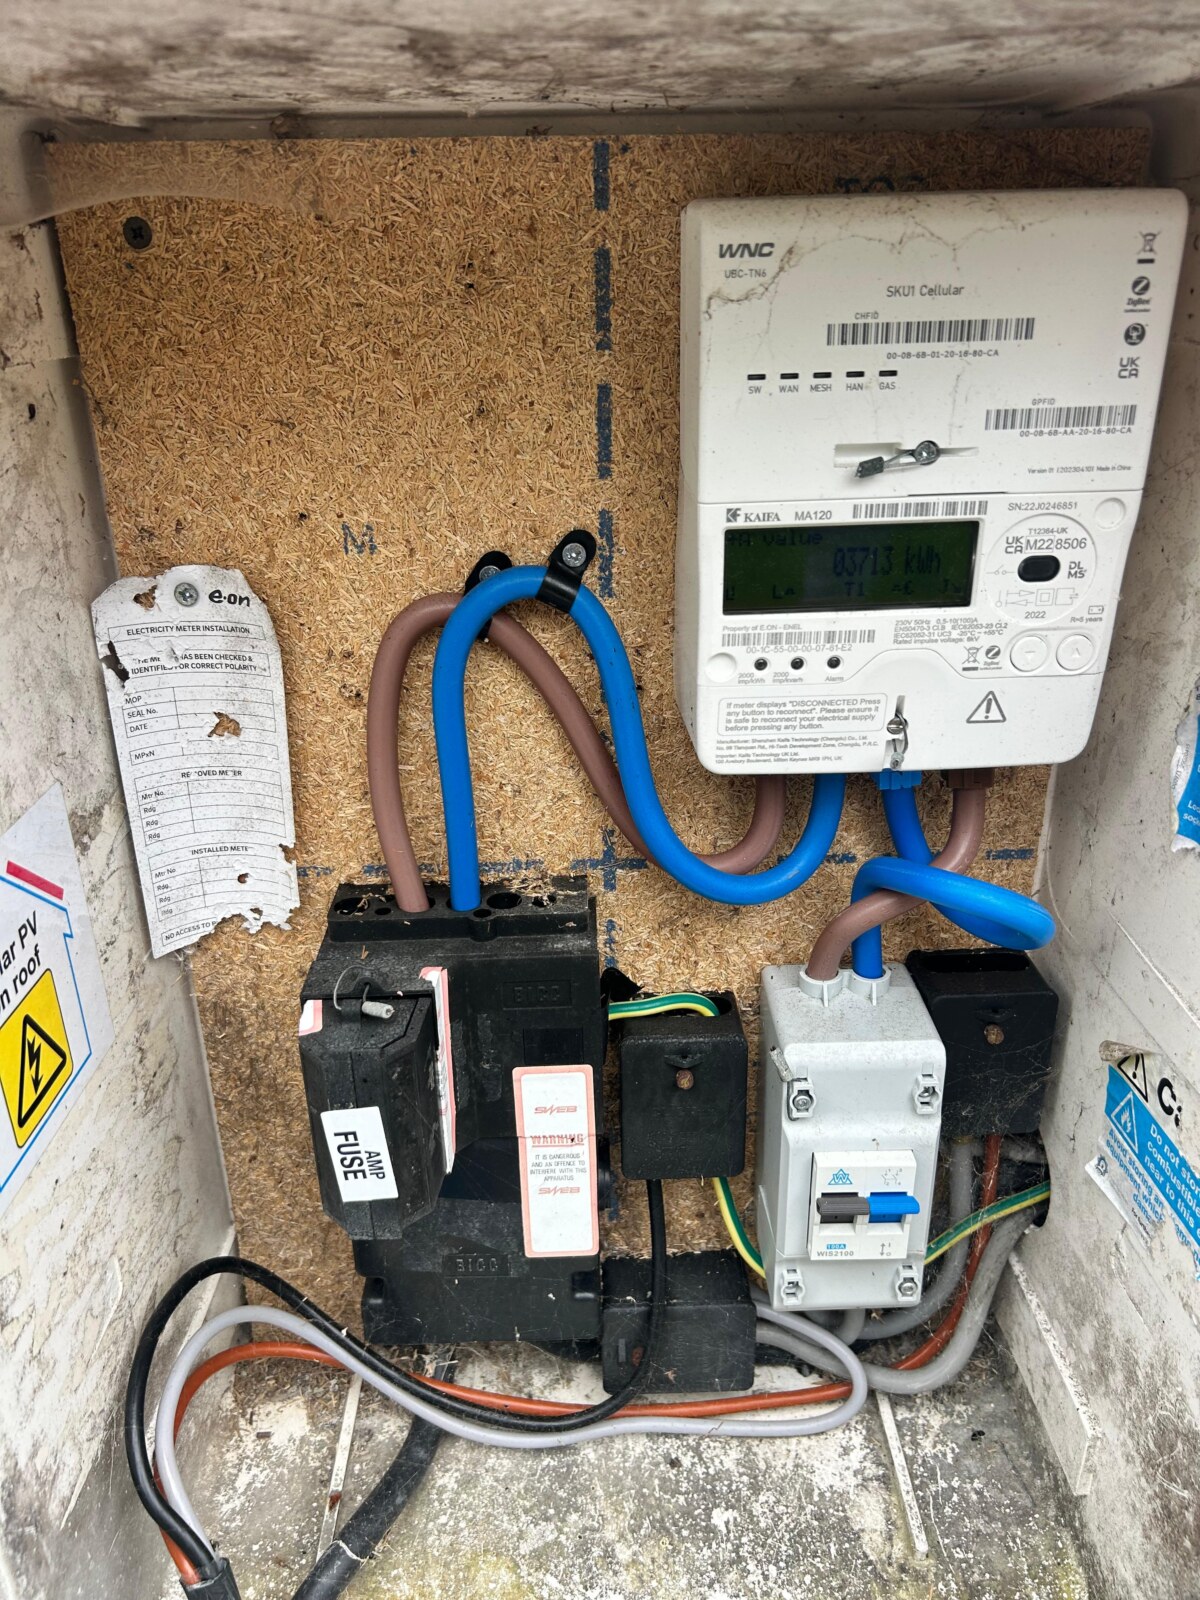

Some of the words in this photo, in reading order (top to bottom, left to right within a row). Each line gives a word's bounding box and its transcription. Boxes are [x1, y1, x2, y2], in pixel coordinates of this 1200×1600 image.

[719, 242, 775, 258] WNC
[724, 268, 767, 279] UBC-TN6
[886, 285, 915, 297] SKU1
[919, 284, 965, 297] Cellular
[854, 311, 879, 320] CHFID
[1119, 356, 1140, 367] UK
[1118, 368, 1139, 379] CA
[748, 386, 762, 394] SW
[779, 385, 799, 393] WAN
[810, 384, 832, 392] MESH
[846, 383, 864, 391] HAN
[878, 382, 896, 390] GAS
[1031, 398, 1056, 406] GPFID
[1007, 502, 1078, 512] SN:22J0246851
[744, 512, 781, 522] KAIFA
[794, 510, 833, 521] MA120
[1006, 536, 1024, 545] UK
[1004, 545, 1023, 554] CA
[1024, 611, 1047, 619] 2022
[126, 626, 175, 636] ELECTRICITY
[202, 625, 250, 634] INSTALLATION
[214, 653, 247, 662] CHECKED
[131, 664, 173, 675] IDENTIFIE
[190, 662, 224, 670] CORRECT
[224, 663, 257, 672] POLARITY
[125, 695, 142, 705] MOP
[756, 700, 787, 709] displays
[127, 710, 145, 719] SEAL
[726, 710, 740, 718] any
[742, 708, 765, 716] button
[820, 706, 846, 714] Please
[798, 715, 815, 723] your
[129, 724, 148, 733] DATE
[725, 724, 749, 732] before
[750, 724, 782, 732] pressing
[134, 750, 155, 761] MPxN
[180, 770, 218, 779] REOVED
[191, 846, 229, 856] INSTALLED
[18, 910, 37, 950] PV
[164, 933, 175, 941] NO
[175, 924, 201, 938] ACCESS
[12, 943, 41, 994] roof
[530, 1133, 585, 1145] WARNING
[1150, 1122, 1163, 1145] Do
[1164, 1144, 1180, 1169] not
[334, 1130, 367, 1181] FUSE
[364, 1150, 386, 1179] AMP
[1106, 1139, 1141, 1193] equipment
[1108, 1128, 1128, 1158] Avoid
[1128, 1156, 1153, 1197] storing
[1144, 1155, 1164, 1184] near
[1165, 1182, 1175, 1201] to
[1177, 1200, 1195, 1229] this
